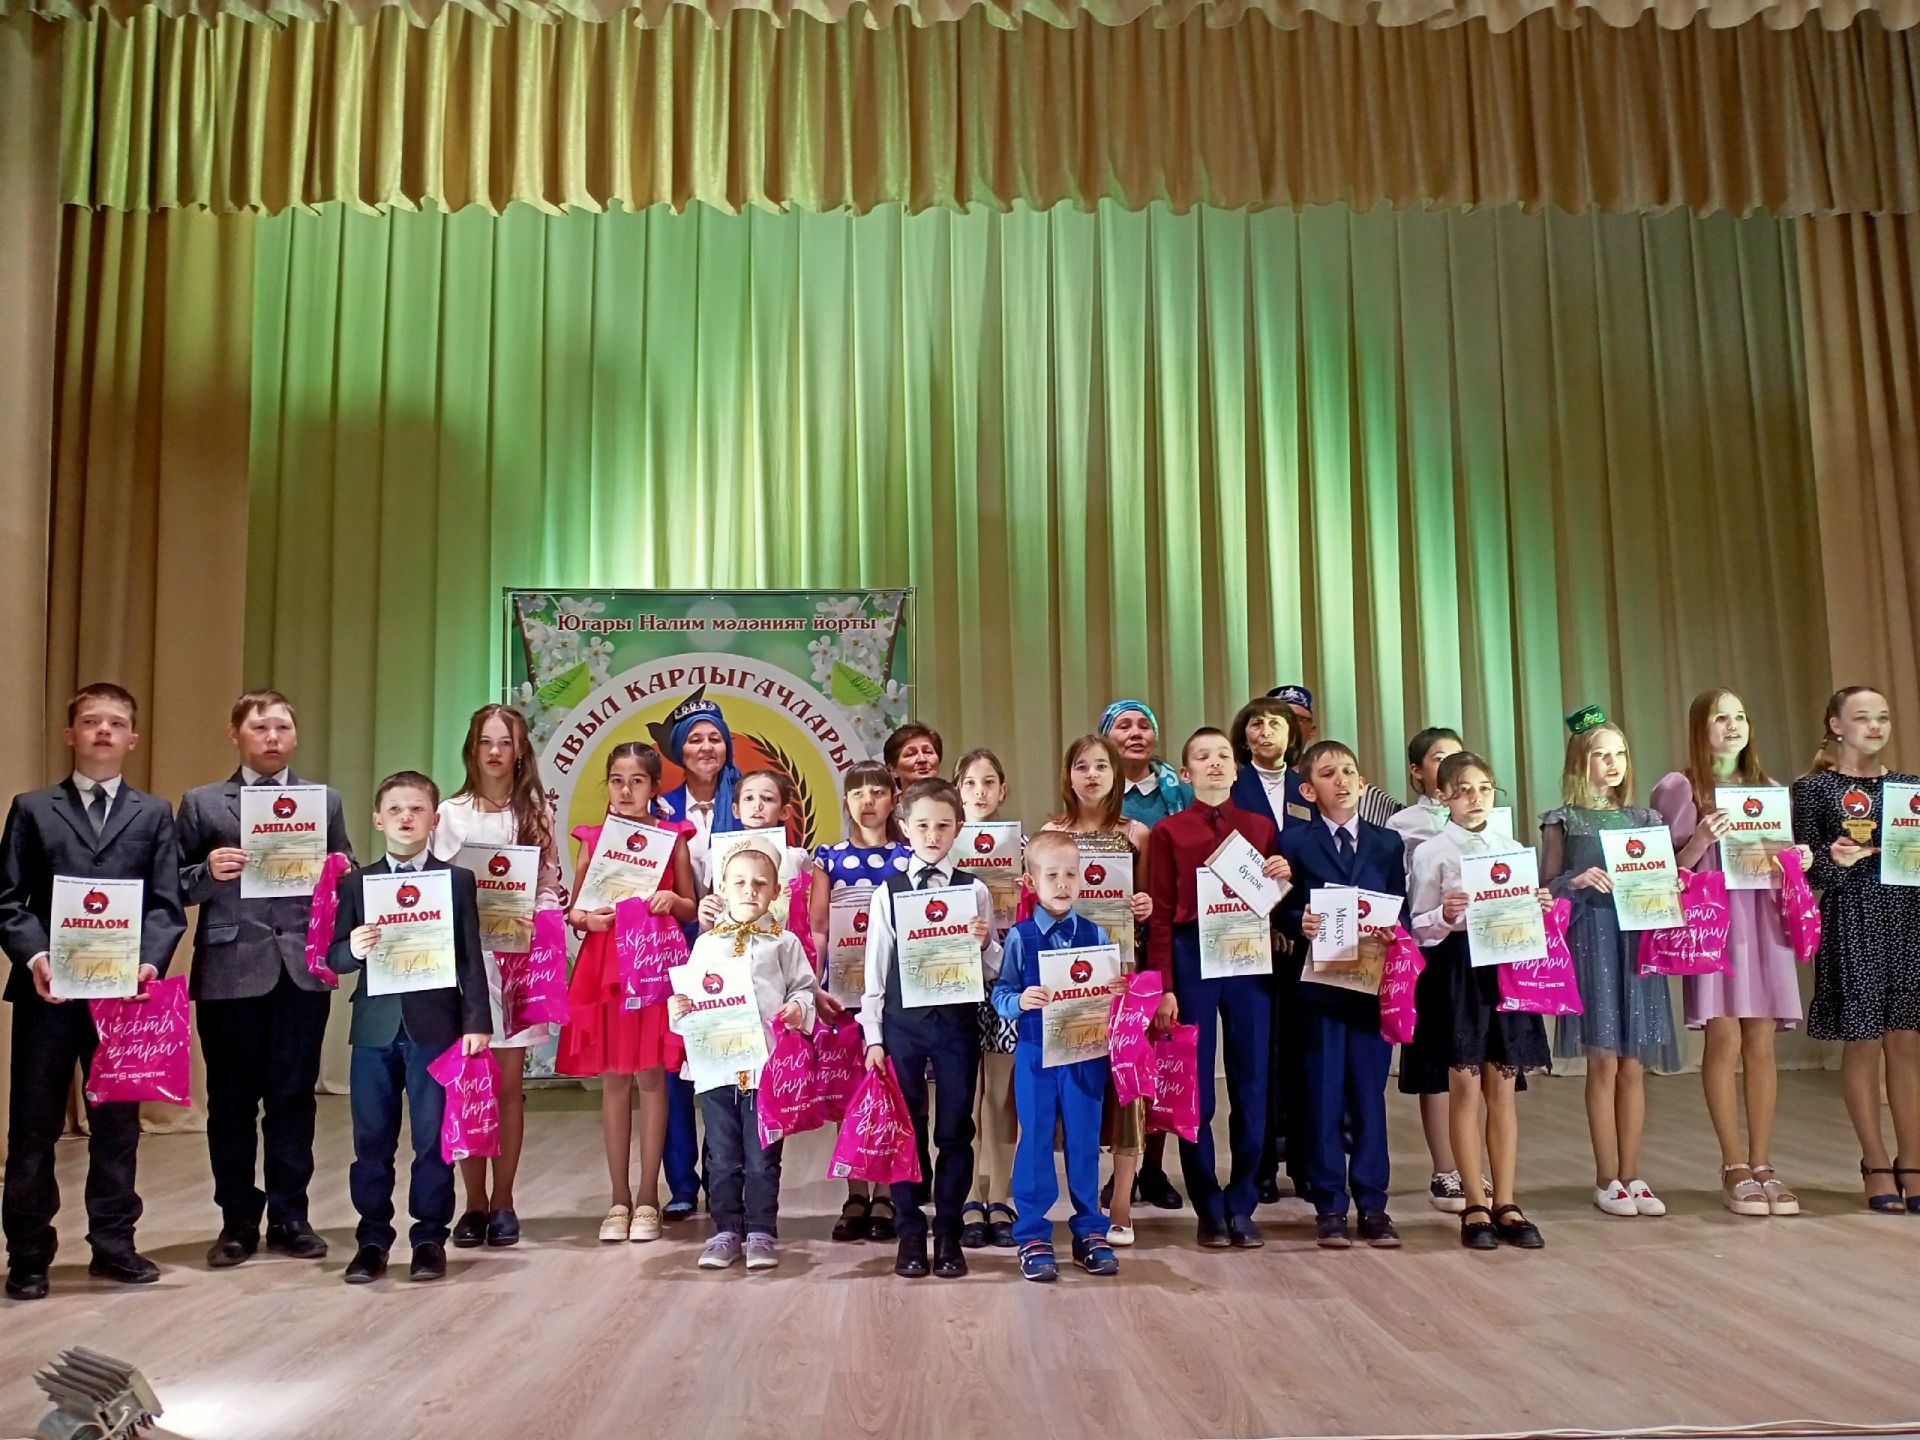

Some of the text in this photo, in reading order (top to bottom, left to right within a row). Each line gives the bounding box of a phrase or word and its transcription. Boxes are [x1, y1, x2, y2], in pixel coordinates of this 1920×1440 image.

[557, 614, 877, 633] Югары Налим мәдәният йорты
[553, 665, 856, 775] АВЫЛ КАРЛЫГАЧЛАРЫ
[252, 821, 316, 834] ДИПЛОМ
[1728, 820, 1781, 831] ДИПЛОМ
[1891, 817, 1920, 827] ДИП
[602, 849, 658, 869] ДИПЛОМ
[957, 857, 1012, 868] ДИПЛОМ
[1246, 848, 1265, 870] Мах
[1615, 860, 1666, 873] ДИПЛОМ
[476, 879, 527, 891] ИПЛОМ
[1474, 885, 1530, 902] ДИПЛОМ
[1077, 889, 1124, 899] ИПЛОМ
[1206, 902, 1249, 915] ДИПЛО
[61, 917, 130, 929] ДИПЛОМ
[376, 909, 441, 926] ДИПЛОМ
[907, 924, 969, 941] ДИПЛОМ
[1334, 907, 1347, 947] Махсус
[1052, 985, 1111, 1002] ДИПЛОМ
[690, 994, 746, 1012] ДИПЛОМ
